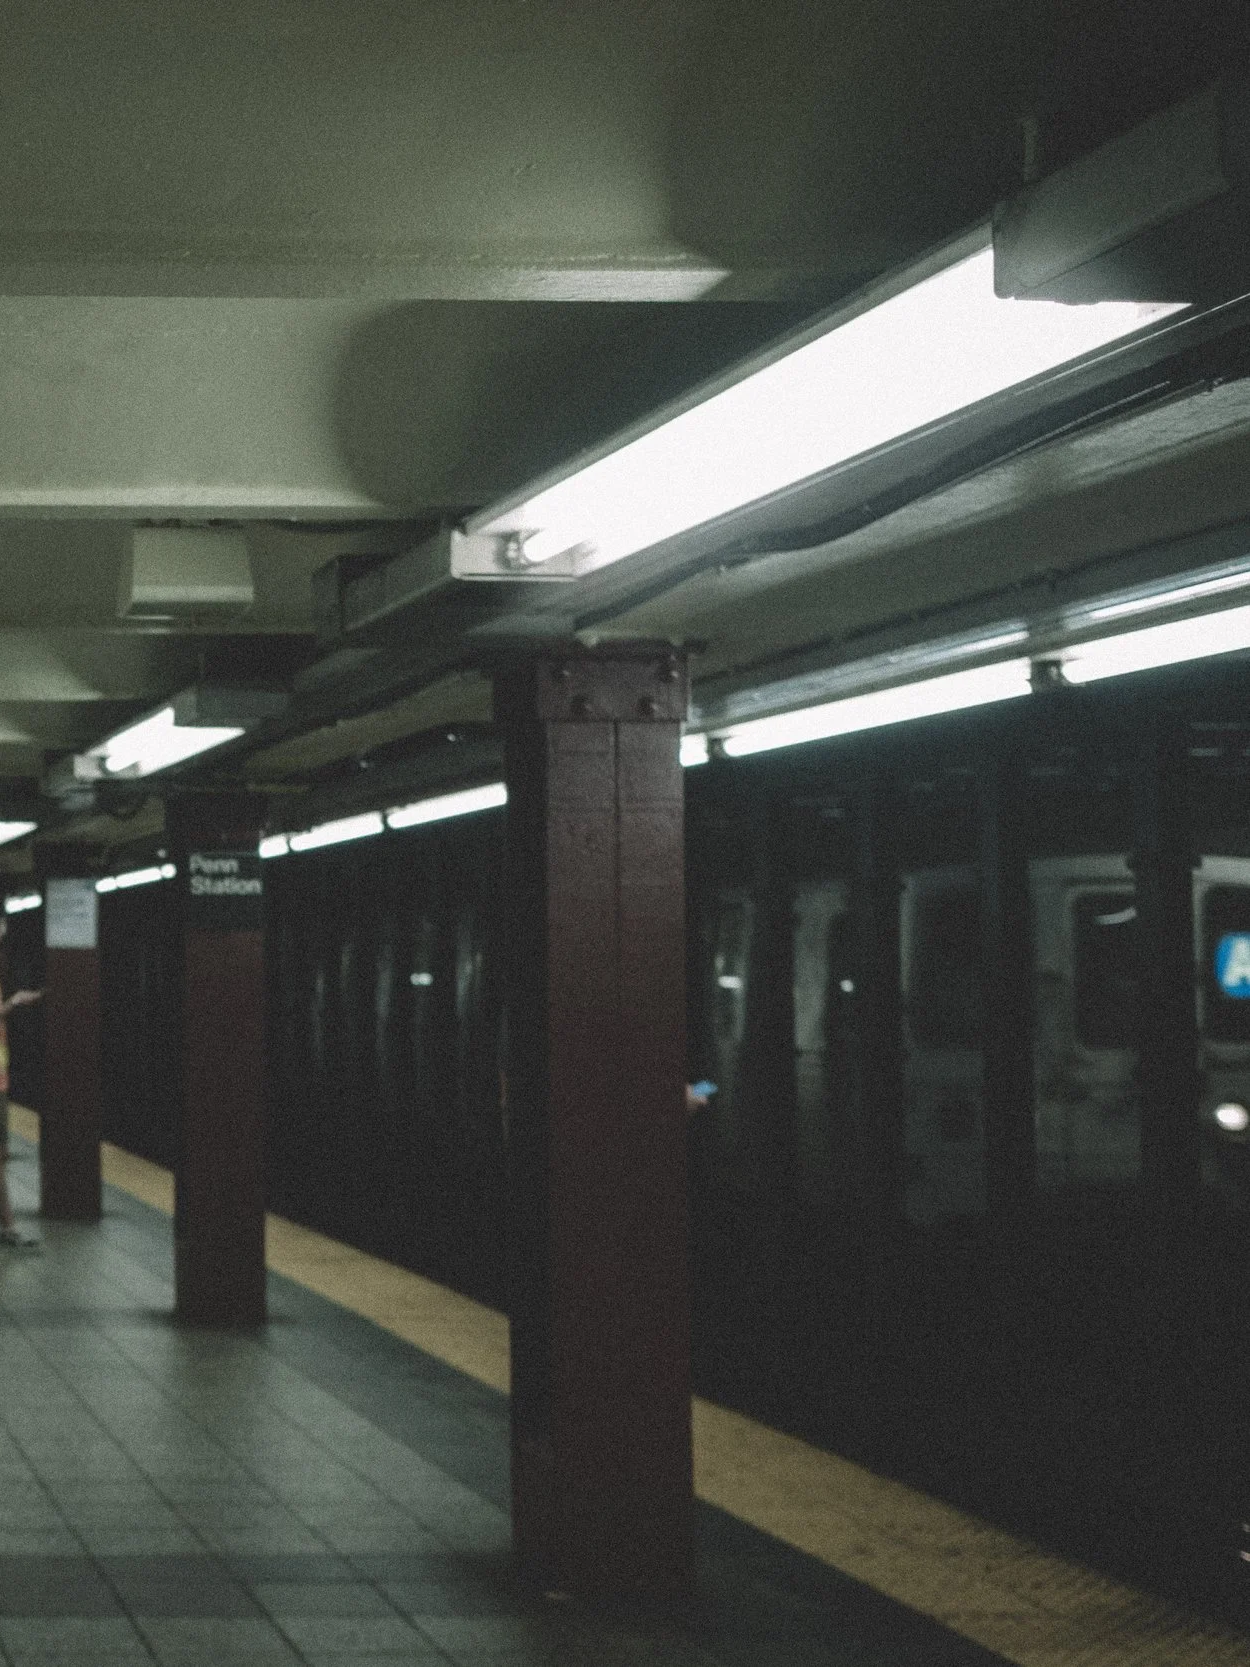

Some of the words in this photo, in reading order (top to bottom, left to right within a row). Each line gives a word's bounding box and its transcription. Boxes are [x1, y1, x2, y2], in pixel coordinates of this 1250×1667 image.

[190, 854, 239, 873] Penn
[191, 876, 263, 895] Station
[1222, 936, 1250, 986] A
